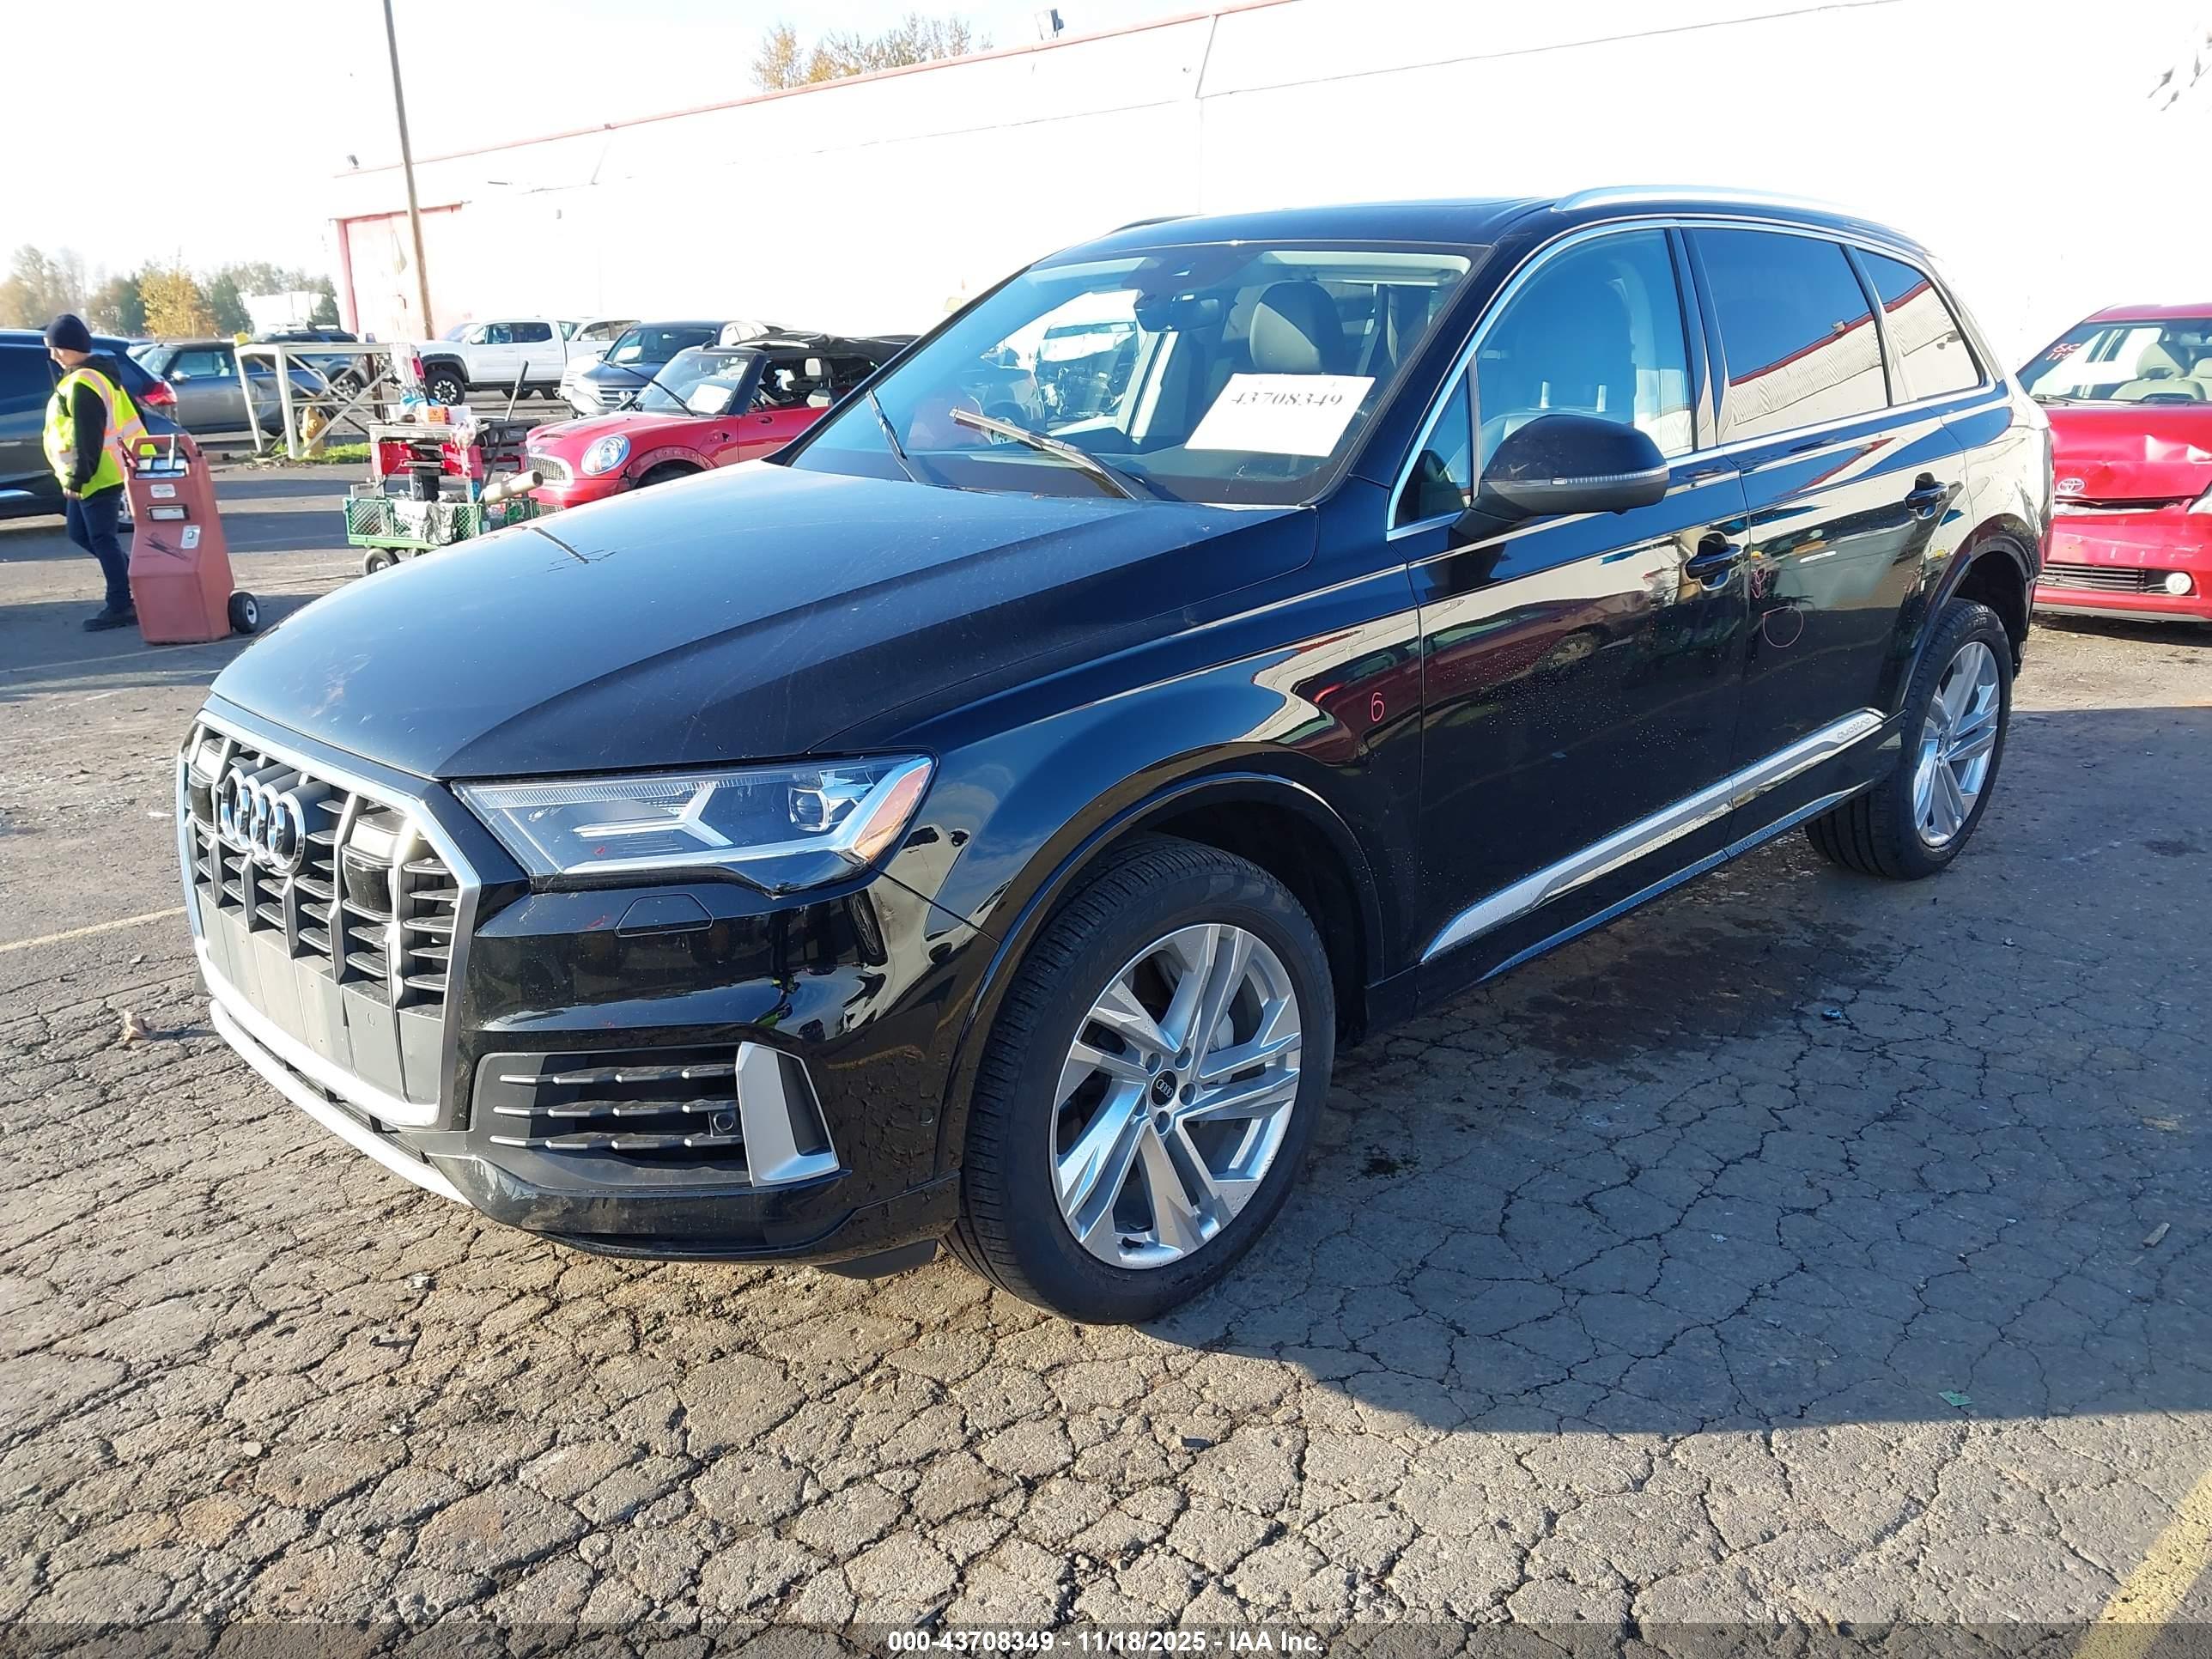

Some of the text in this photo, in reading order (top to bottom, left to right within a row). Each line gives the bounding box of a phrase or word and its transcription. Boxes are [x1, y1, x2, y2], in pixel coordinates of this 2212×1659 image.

[1231, 392, 1343, 406] 43708349
[1370, 691, 1385, 722] 6
[1837, 717, 1871, 739] quattro
